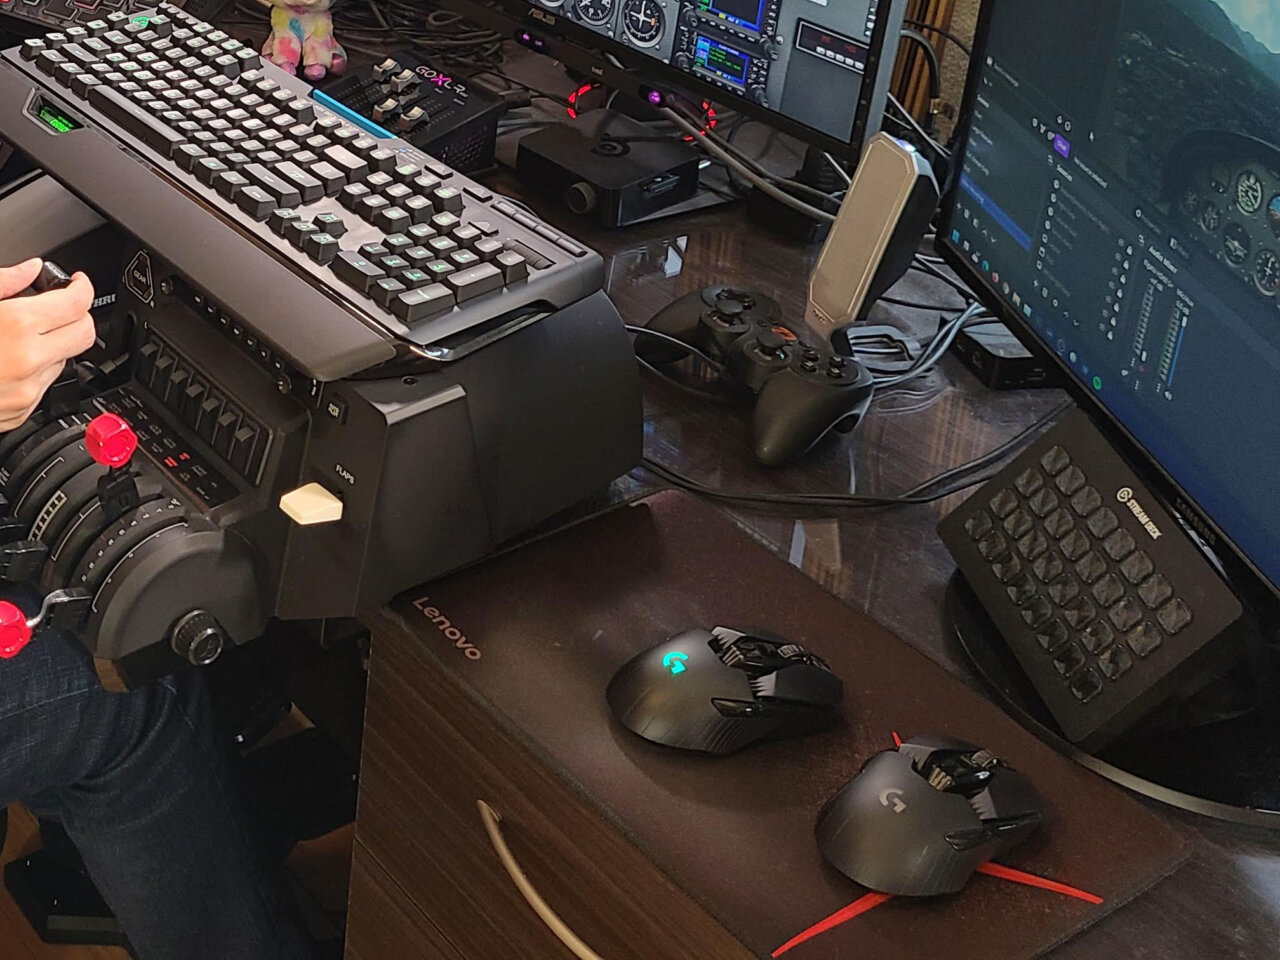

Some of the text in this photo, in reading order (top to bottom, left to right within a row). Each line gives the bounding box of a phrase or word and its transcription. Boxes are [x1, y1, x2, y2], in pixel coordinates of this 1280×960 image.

[133, 269, 147, 285] GEAR
[335, 464, 355, 485] FLAPS
[1126, 499, 1163, 540] STREAM DECK
[412, 595, 482, 660] Lenovo
